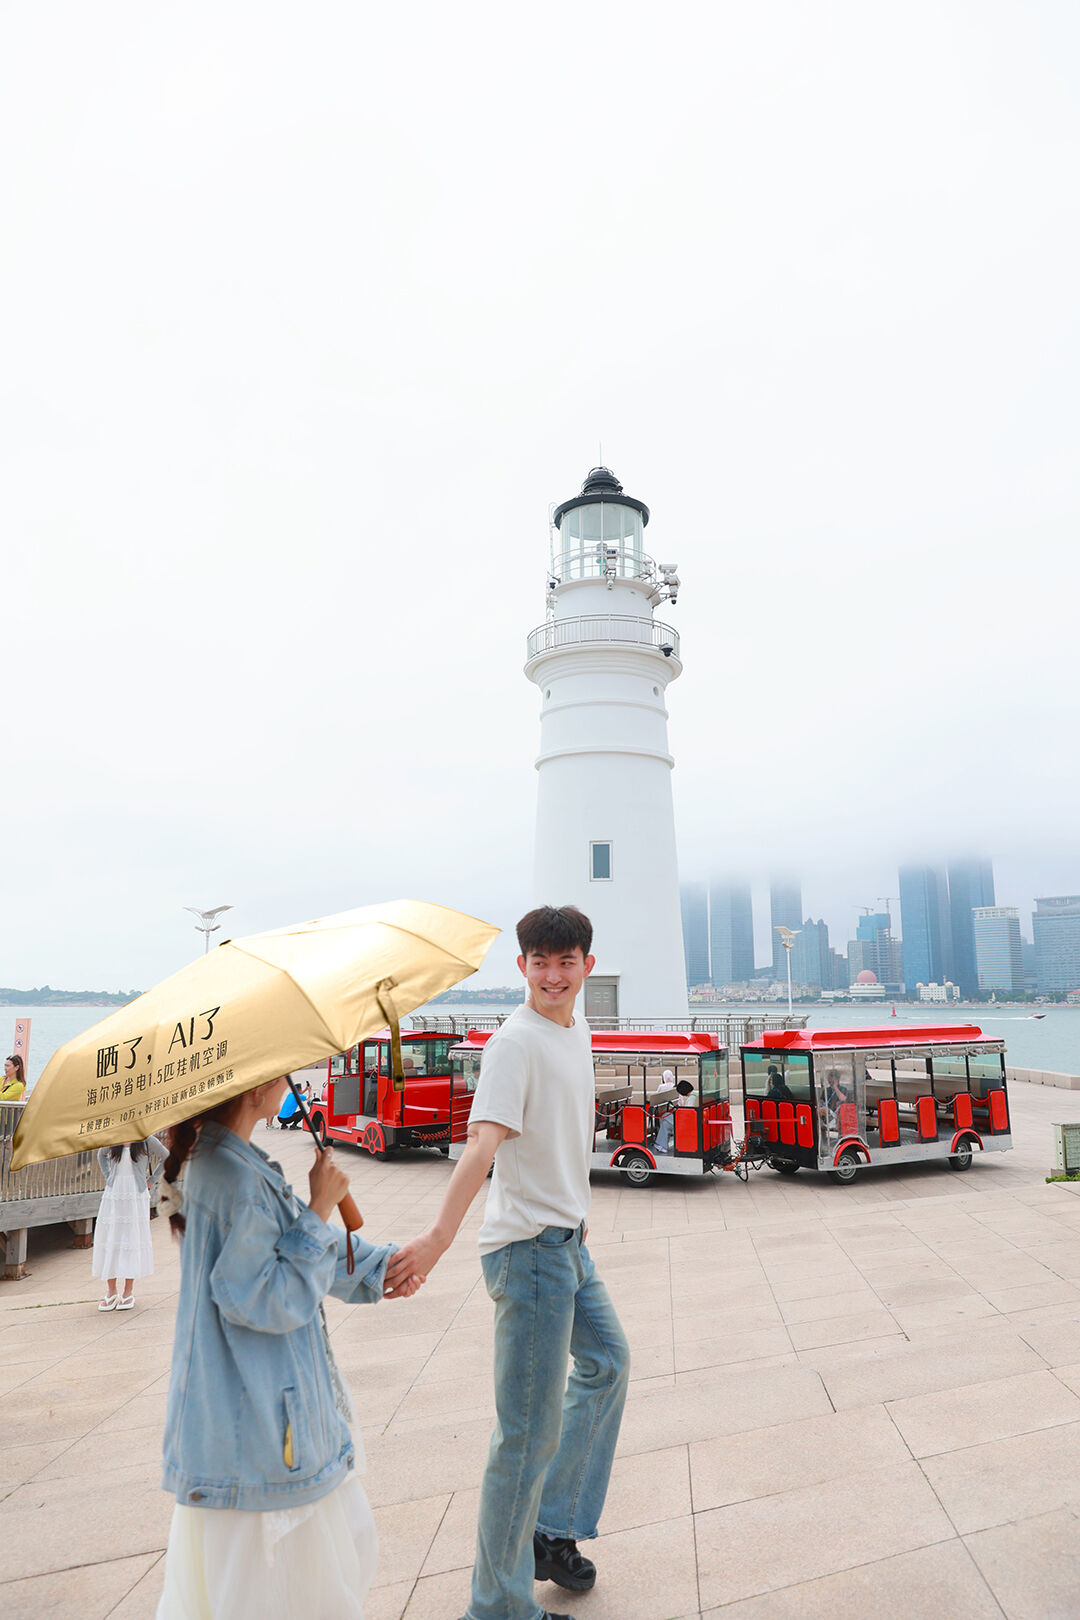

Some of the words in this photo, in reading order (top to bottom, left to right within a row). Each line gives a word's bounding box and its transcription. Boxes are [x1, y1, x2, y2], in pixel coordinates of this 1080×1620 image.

[87, 1041, 228, 1106] 海尔净省电1.5匹挂机空调
